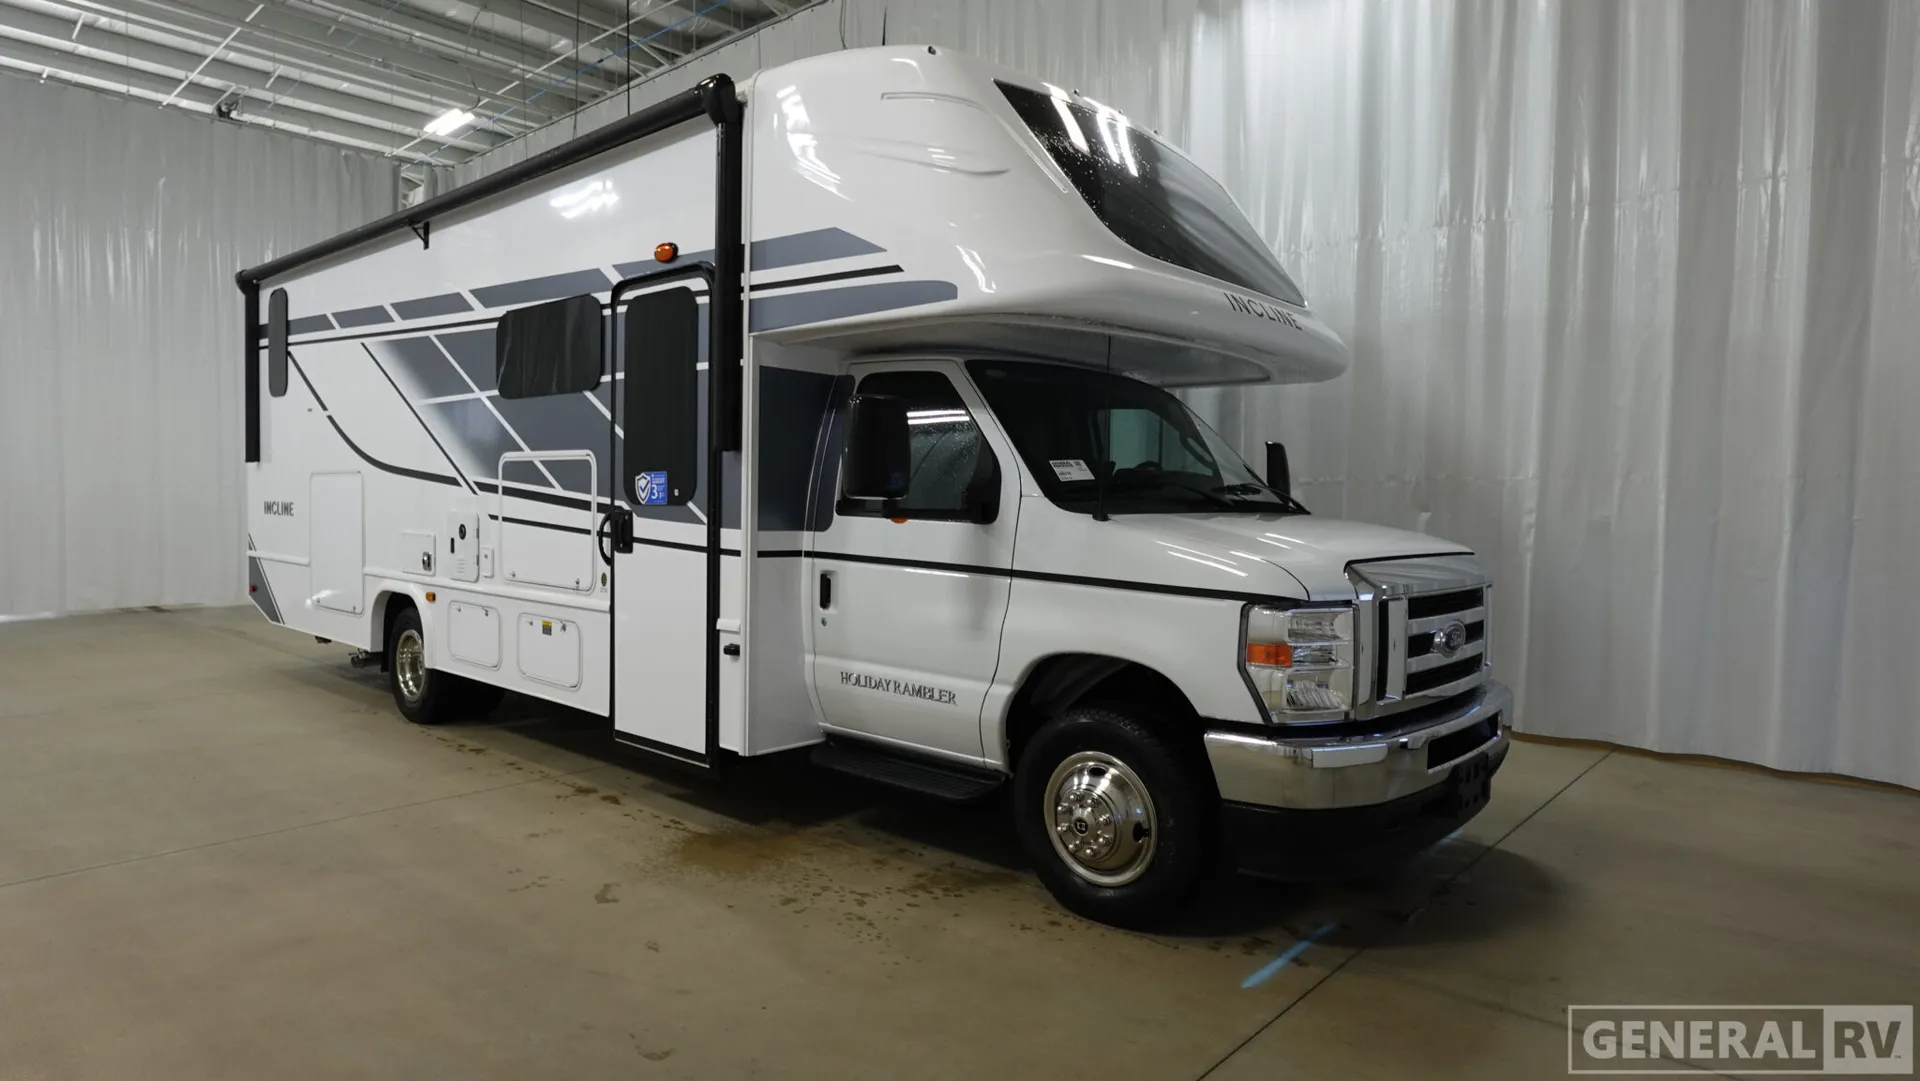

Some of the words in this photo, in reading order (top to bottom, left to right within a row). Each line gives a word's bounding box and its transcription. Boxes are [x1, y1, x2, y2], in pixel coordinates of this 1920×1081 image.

[1223, 292, 1303, 331] INCLINE
[651, 484, 658, 499] 3
[263, 500, 295, 517] INCLINE
[840, 671, 892, 692] HOLIDAY
[893, 680, 958, 706] RAMBLER
